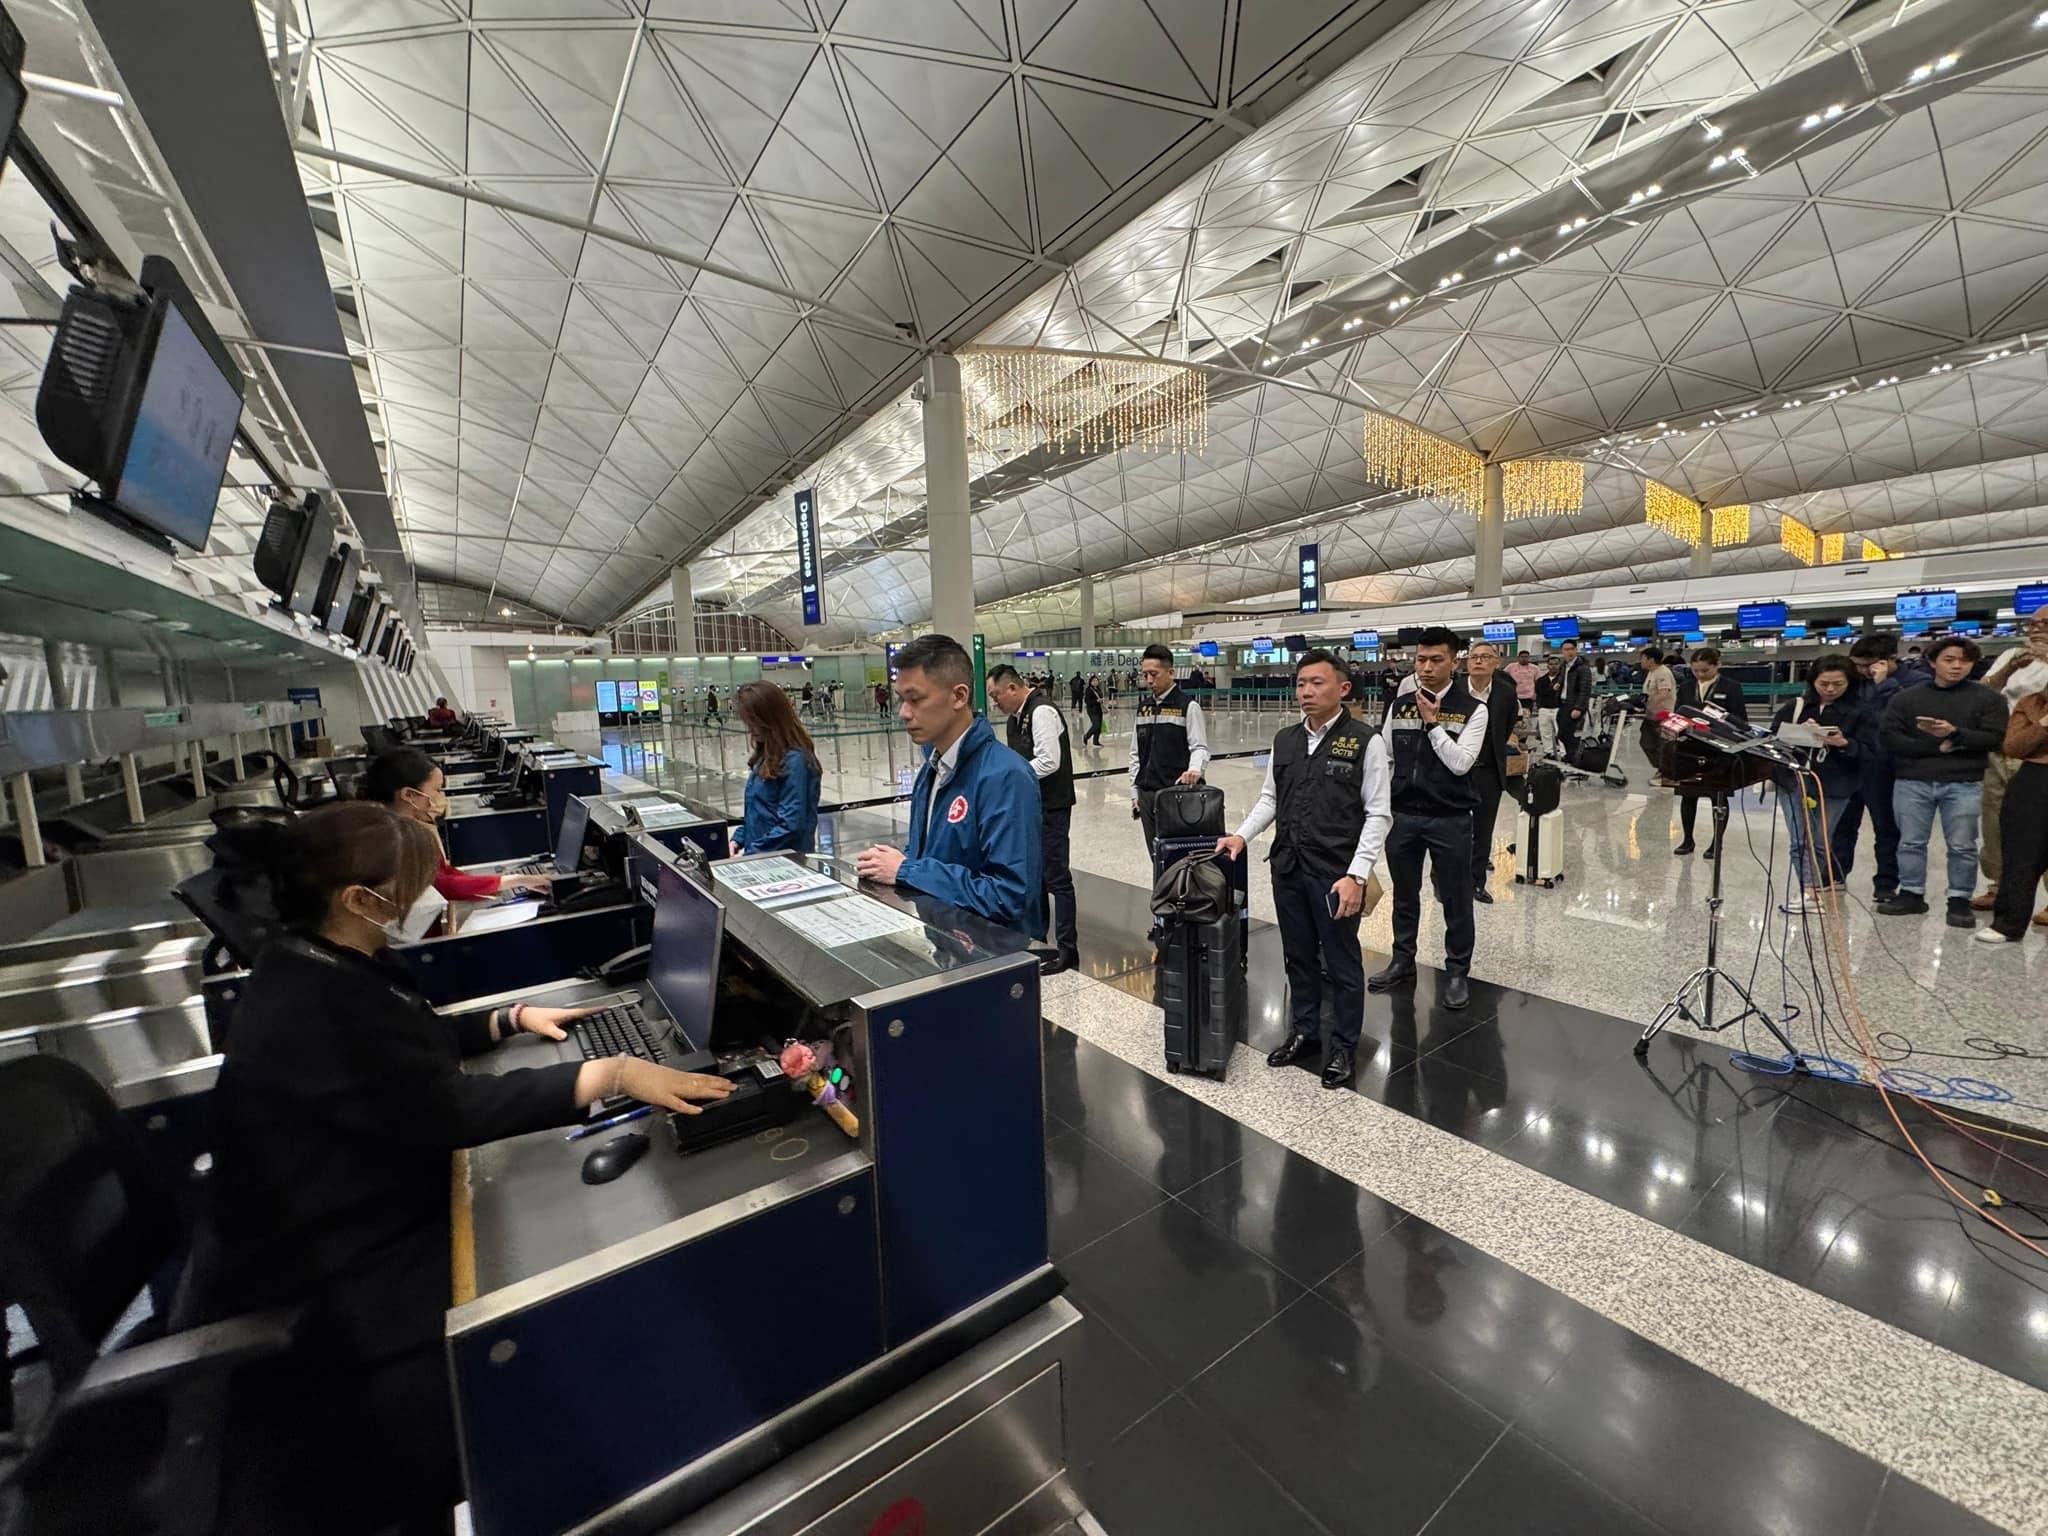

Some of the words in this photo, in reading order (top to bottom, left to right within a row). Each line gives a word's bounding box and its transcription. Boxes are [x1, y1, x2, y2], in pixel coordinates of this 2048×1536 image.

[800, 502, 812, 577] Departures
[1332, 740, 1360, 750] POLICE
[1332, 747, 1354, 758] OCTB
